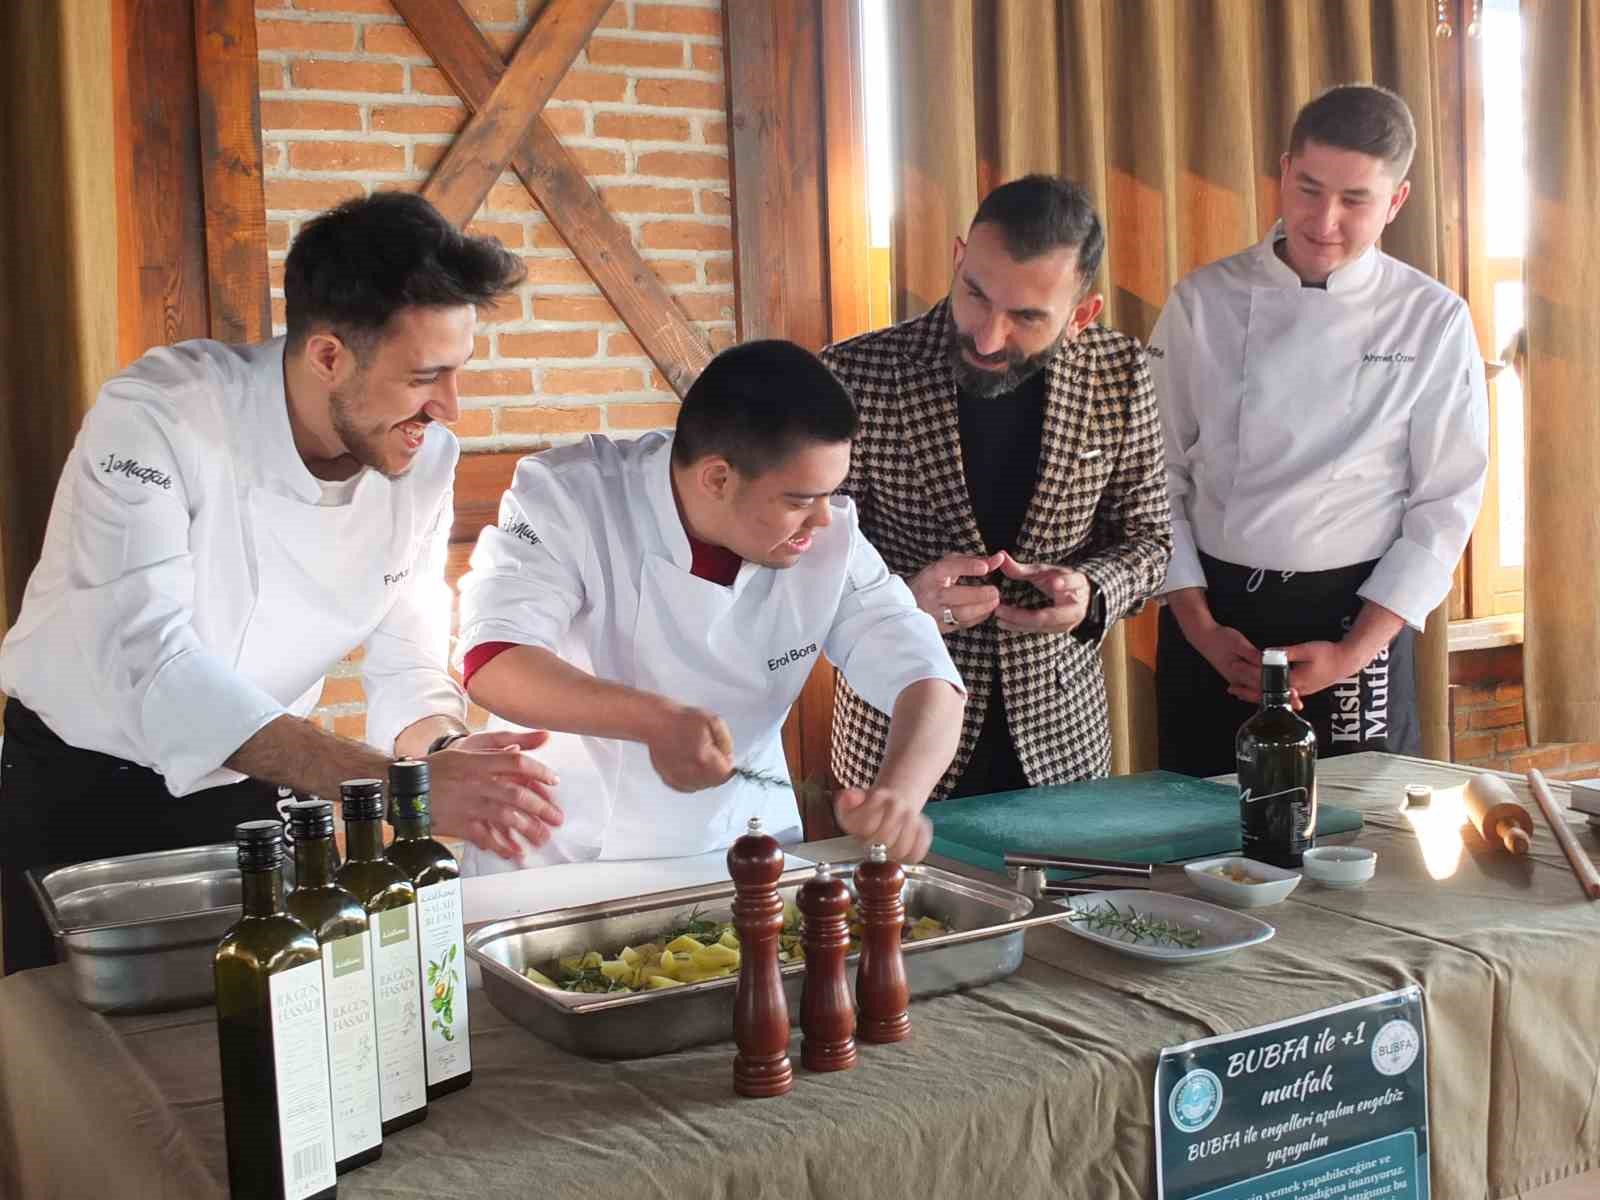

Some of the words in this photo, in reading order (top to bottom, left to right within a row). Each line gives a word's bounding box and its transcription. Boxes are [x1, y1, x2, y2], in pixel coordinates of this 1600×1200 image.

[767, 652, 790, 671] Erol
[789, 643, 817, 662] Bora
[1227, 1035, 1309, 1077] BUBFA
[1314, 1027, 1336, 1053] ile
[1341, 1021, 1366, 1045] +1
[1378, 1039, 1415, 1057] BUBFA
[1260, 1064, 1333, 1106] mutfak
[1187, 1131, 1240, 1161] BUBFA
[1244, 1125, 1257, 1144] ile
[1261, 1112, 1315, 1142] engelleri
[1315, 1102, 1355, 1128] aşalım
[1357, 1088, 1404, 1115] engelsiz
[1264, 1133, 1329, 1169] yaşayalım
[1265, 1180, 1301, 1199] yemek
[1378, 1155, 1391, 1165] ve
